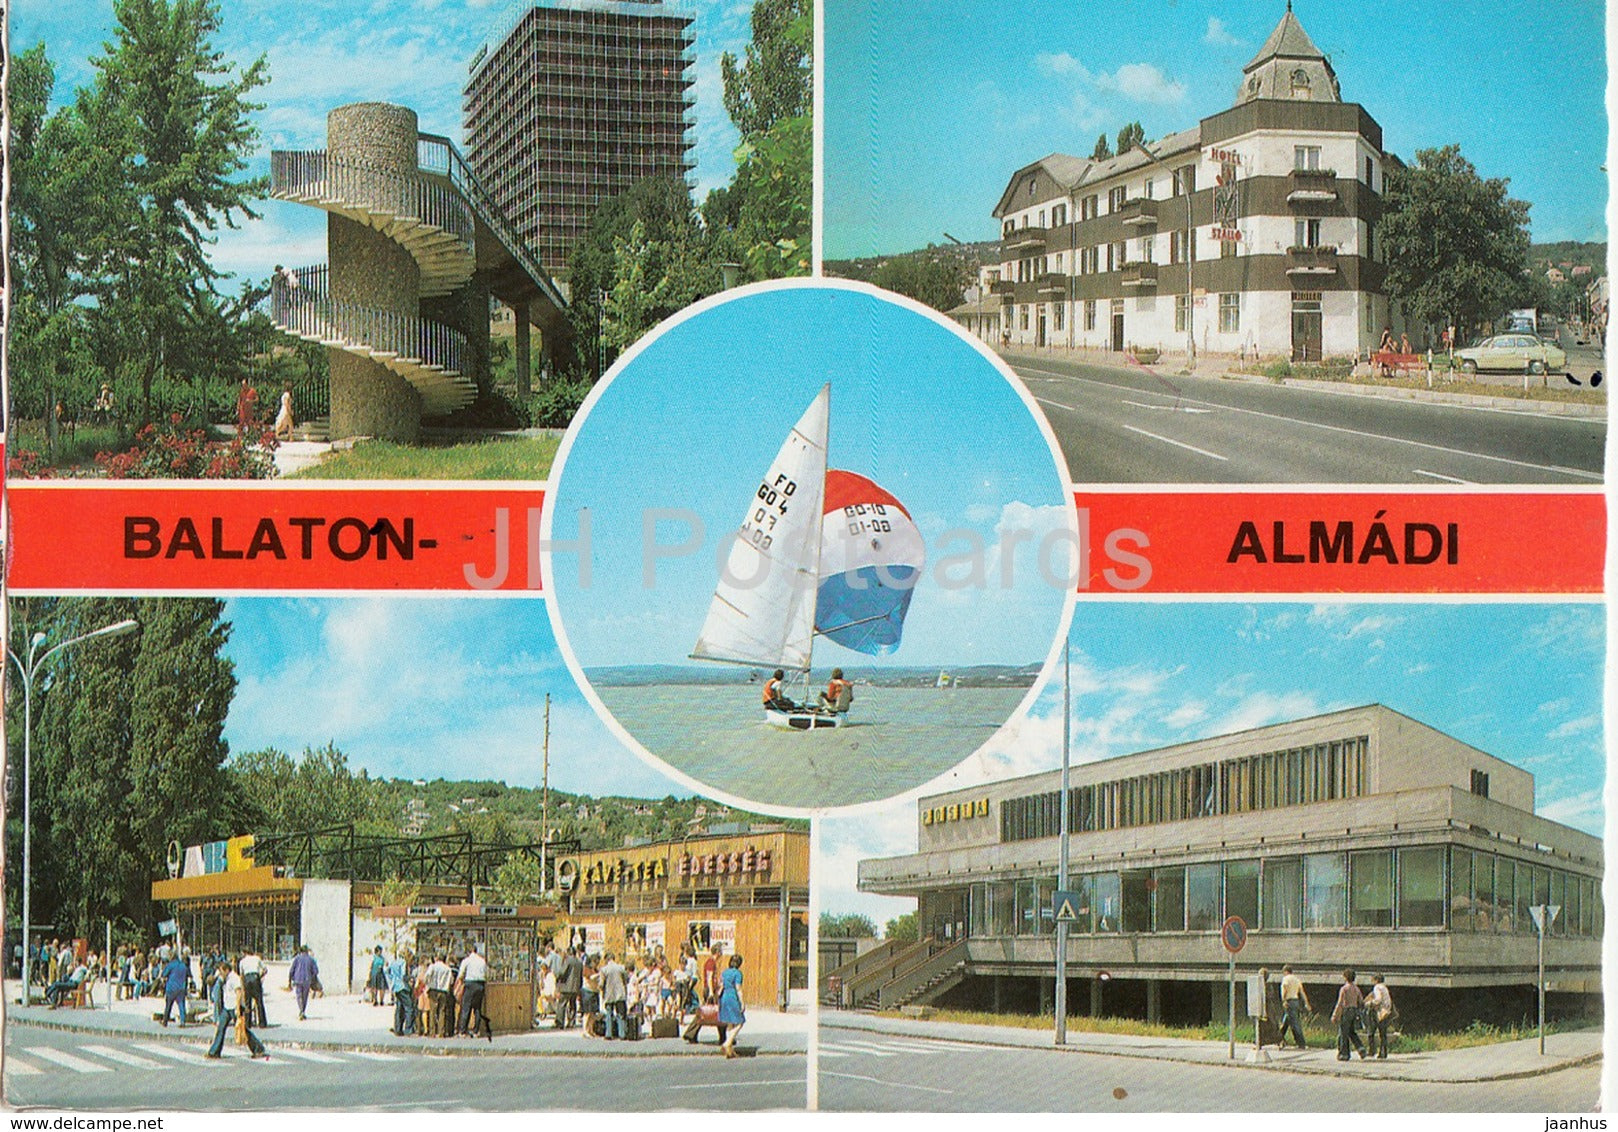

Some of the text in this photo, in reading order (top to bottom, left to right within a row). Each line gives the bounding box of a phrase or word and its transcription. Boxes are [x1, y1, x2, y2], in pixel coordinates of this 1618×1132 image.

[774, 473, 797, 497] FD
[124, 516, 437, 561] BALATON-
[1226, 509, 1458, 564] ALMÁDI
[922, 798, 989, 826] POSTA
[183, 834, 255, 878] ABC
